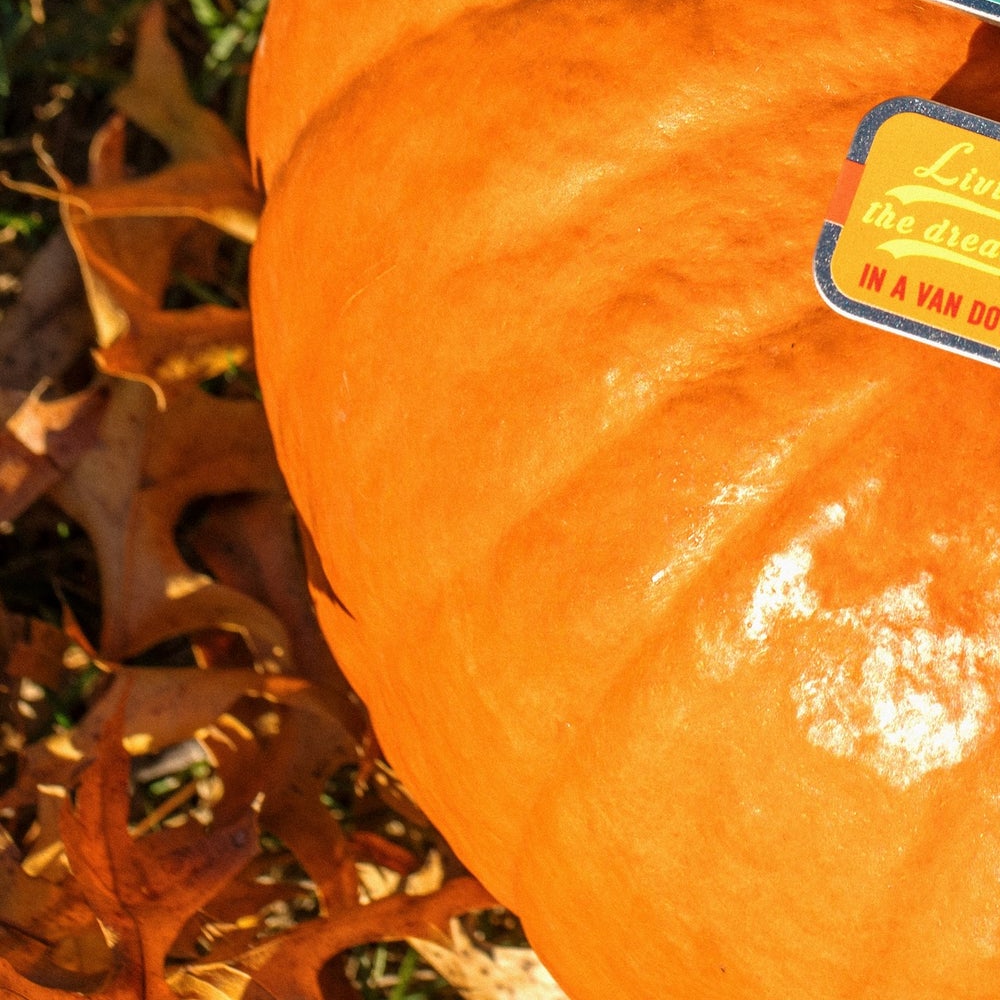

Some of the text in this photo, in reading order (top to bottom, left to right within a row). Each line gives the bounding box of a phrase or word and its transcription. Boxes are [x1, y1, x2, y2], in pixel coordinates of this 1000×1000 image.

[861, 200, 914, 235] the
[858, 263, 888, 292] IN
[891, 278, 908, 302] A
[918, 282, 964, 319] VAN
